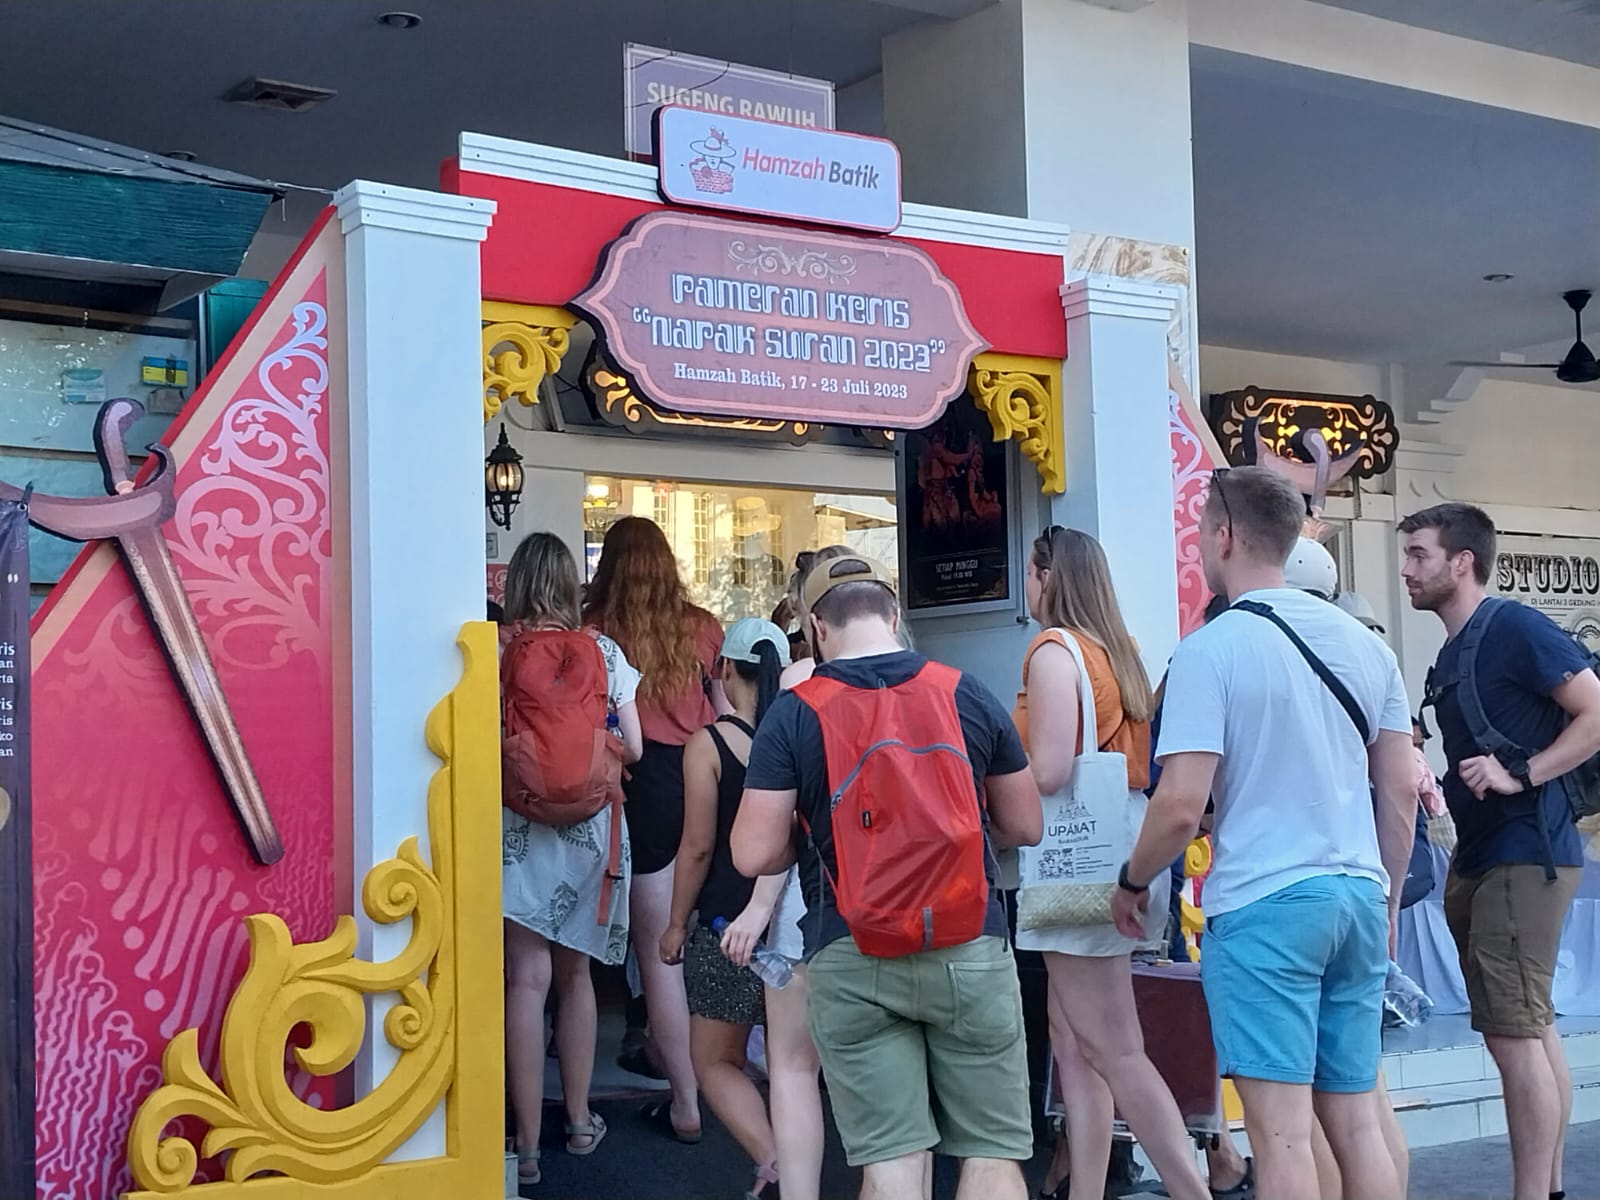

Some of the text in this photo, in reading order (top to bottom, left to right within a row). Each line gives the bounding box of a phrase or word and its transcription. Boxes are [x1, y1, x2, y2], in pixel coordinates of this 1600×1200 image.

[647, 81, 734, 114] SUGENG
[742, 146, 880, 189] Hamzah Batik
[674, 362, 736, 383] Hamzah
[740, 369, 786, 390] Batik,
[791, 375, 807, 389] 17
[820, 377, 838, 393] 23
[842, 379, 870, 396] Juli
[873, 382, 908, 399] 2023
[1497, 552, 1599, 595] STUDIO
